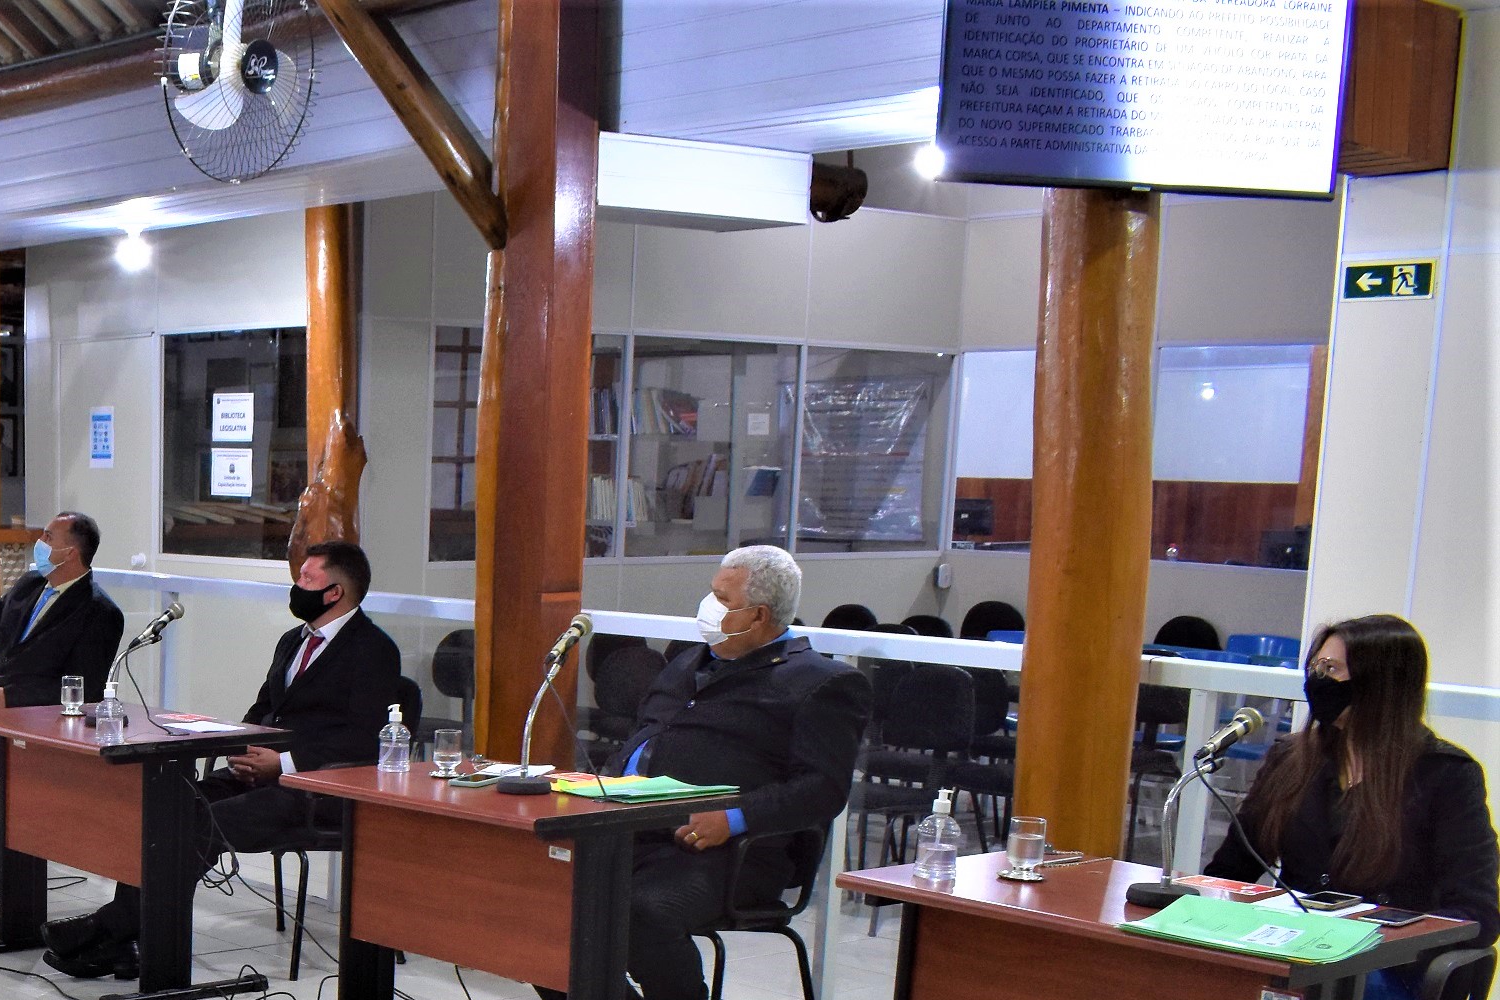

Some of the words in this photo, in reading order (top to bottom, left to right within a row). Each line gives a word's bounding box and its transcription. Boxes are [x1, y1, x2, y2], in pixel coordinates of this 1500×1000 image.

[967, 0, 1003, 8] MARIA
[1009, 0, 1056, 10] LAMPIER
[1061, 1, 1109, 14] PIMENTA
[1125, 5, 1184, 19] INDICANDO
[1189, 11, 1203, 20] AO
[1283, 1, 1333, 13] LORRAINE
[965, 12, 979, 24] DE
[995, 14, 1030, 27] JUNTO
[1046, 18, 1062, 28] AO
[1077, 19, 1161, 35] DEPARTAMENTO
[964, 31, 1044, 46] IDENTIFICAÇÃO
[1051, 36, 1068, 46] DO
[1075, 37, 1148, 52] PROPRIETÁRIO
[963, 48, 1001, 60] MARCA
[1005, 50, 1043, 65] CORSA,
[1047, 53, 1069, 65] QUE
[1073, 54, 1084, 65] SE
[1088, 55, 1144, 69] ENCONTRA
[1302, 70, 1327, 80] PARA
[961, 65, 984, 77] QUE
[989, 66, 998, 77] O
[1002, 67, 1044, 80] MESMO
[1047, 70, 1081, 82] POSSA
[1085, 72, 1116, 84] FAZER
[1119, 74, 1127, 84] A
[1300, 87, 1326, 98] CASO
[961, 81, 984, 95] NÃO
[995, 84, 1019, 96] SEJA
[1030, 86, 1105, 102] IDENTIFICADO,
[1117, 92, 1139, 103] QUE
[959, 100, 1023, 114] PREFEITURA
[1027, 103, 1063, 117] FAÇAM
[1066, 105, 1073, 115] A
[1077, 106, 1127, 120] RETIRADA
[1131, 110, 1146, 121] DO
[958, 117, 975, 129] DO
[981, 118, 1012, 131] NOVO
[1018, 120, 1104, 135] SUPERMERCADO
[957, 135, 997, 147] ACESSO
[1000, 137, 1007, 148] A
[1010, 138, 1042, 150] PARTE
[1044, 140, 1131, 155] ADMINISTRATIVA
